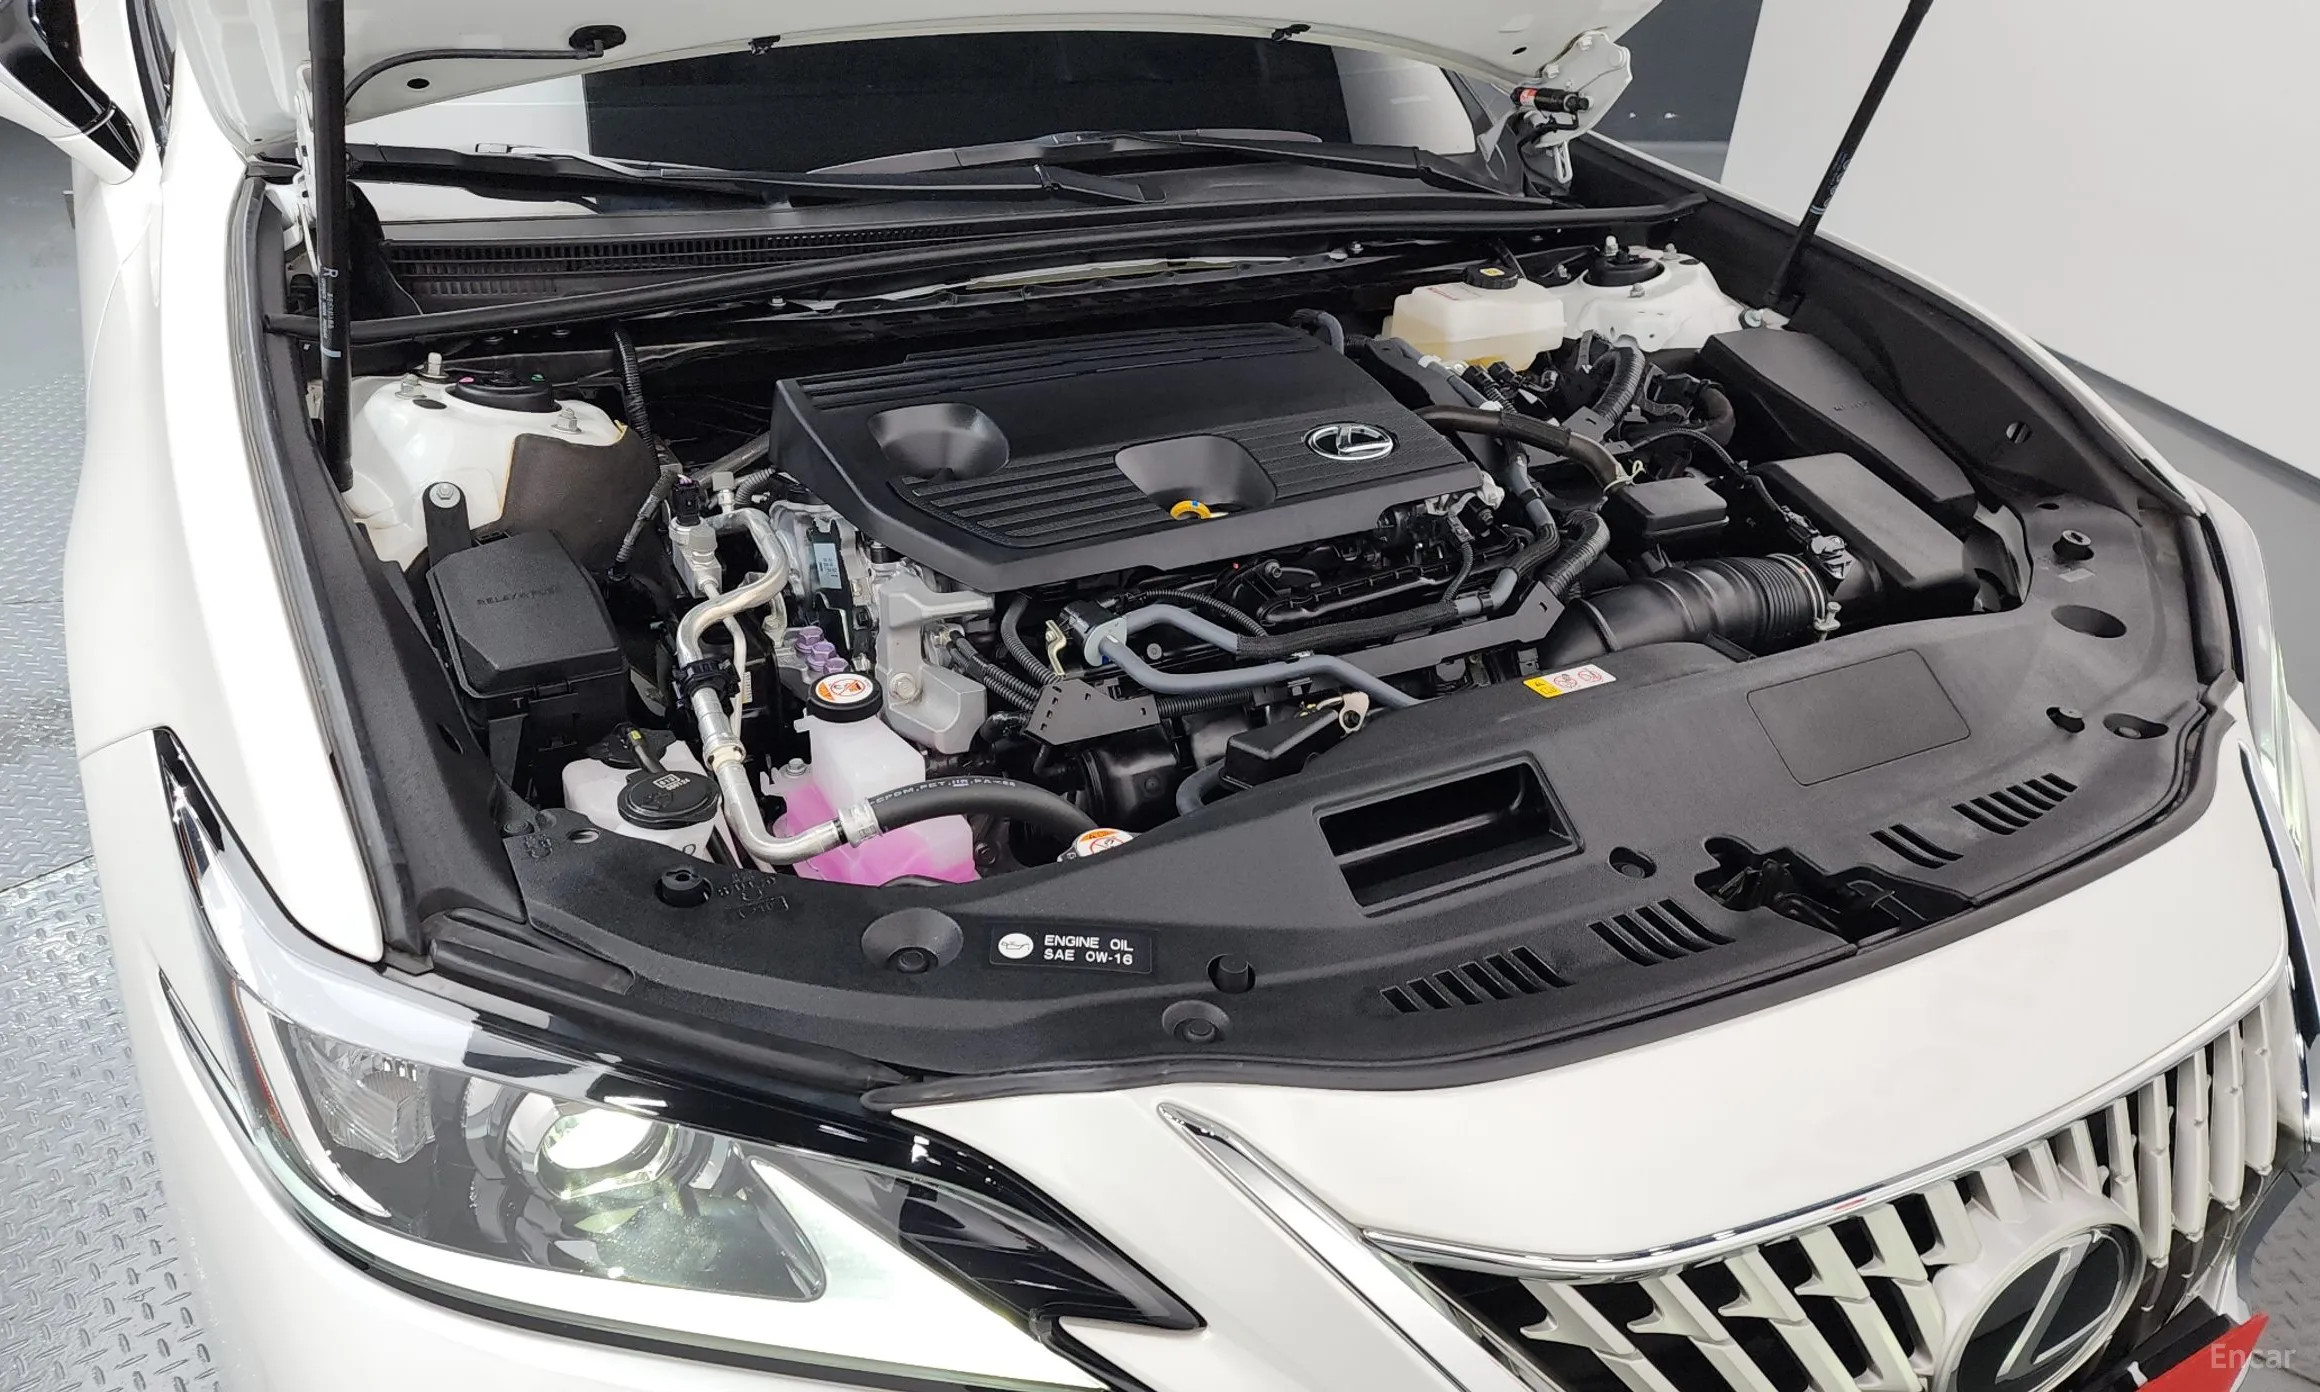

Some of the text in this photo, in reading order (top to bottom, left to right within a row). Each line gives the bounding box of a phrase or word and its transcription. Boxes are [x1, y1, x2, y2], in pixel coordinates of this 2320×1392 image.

[323, 267, 339, 278] R
[1044, 934, 1134, 952] ENGINE OIL
[1043, 949, 1075, 962] SAE
